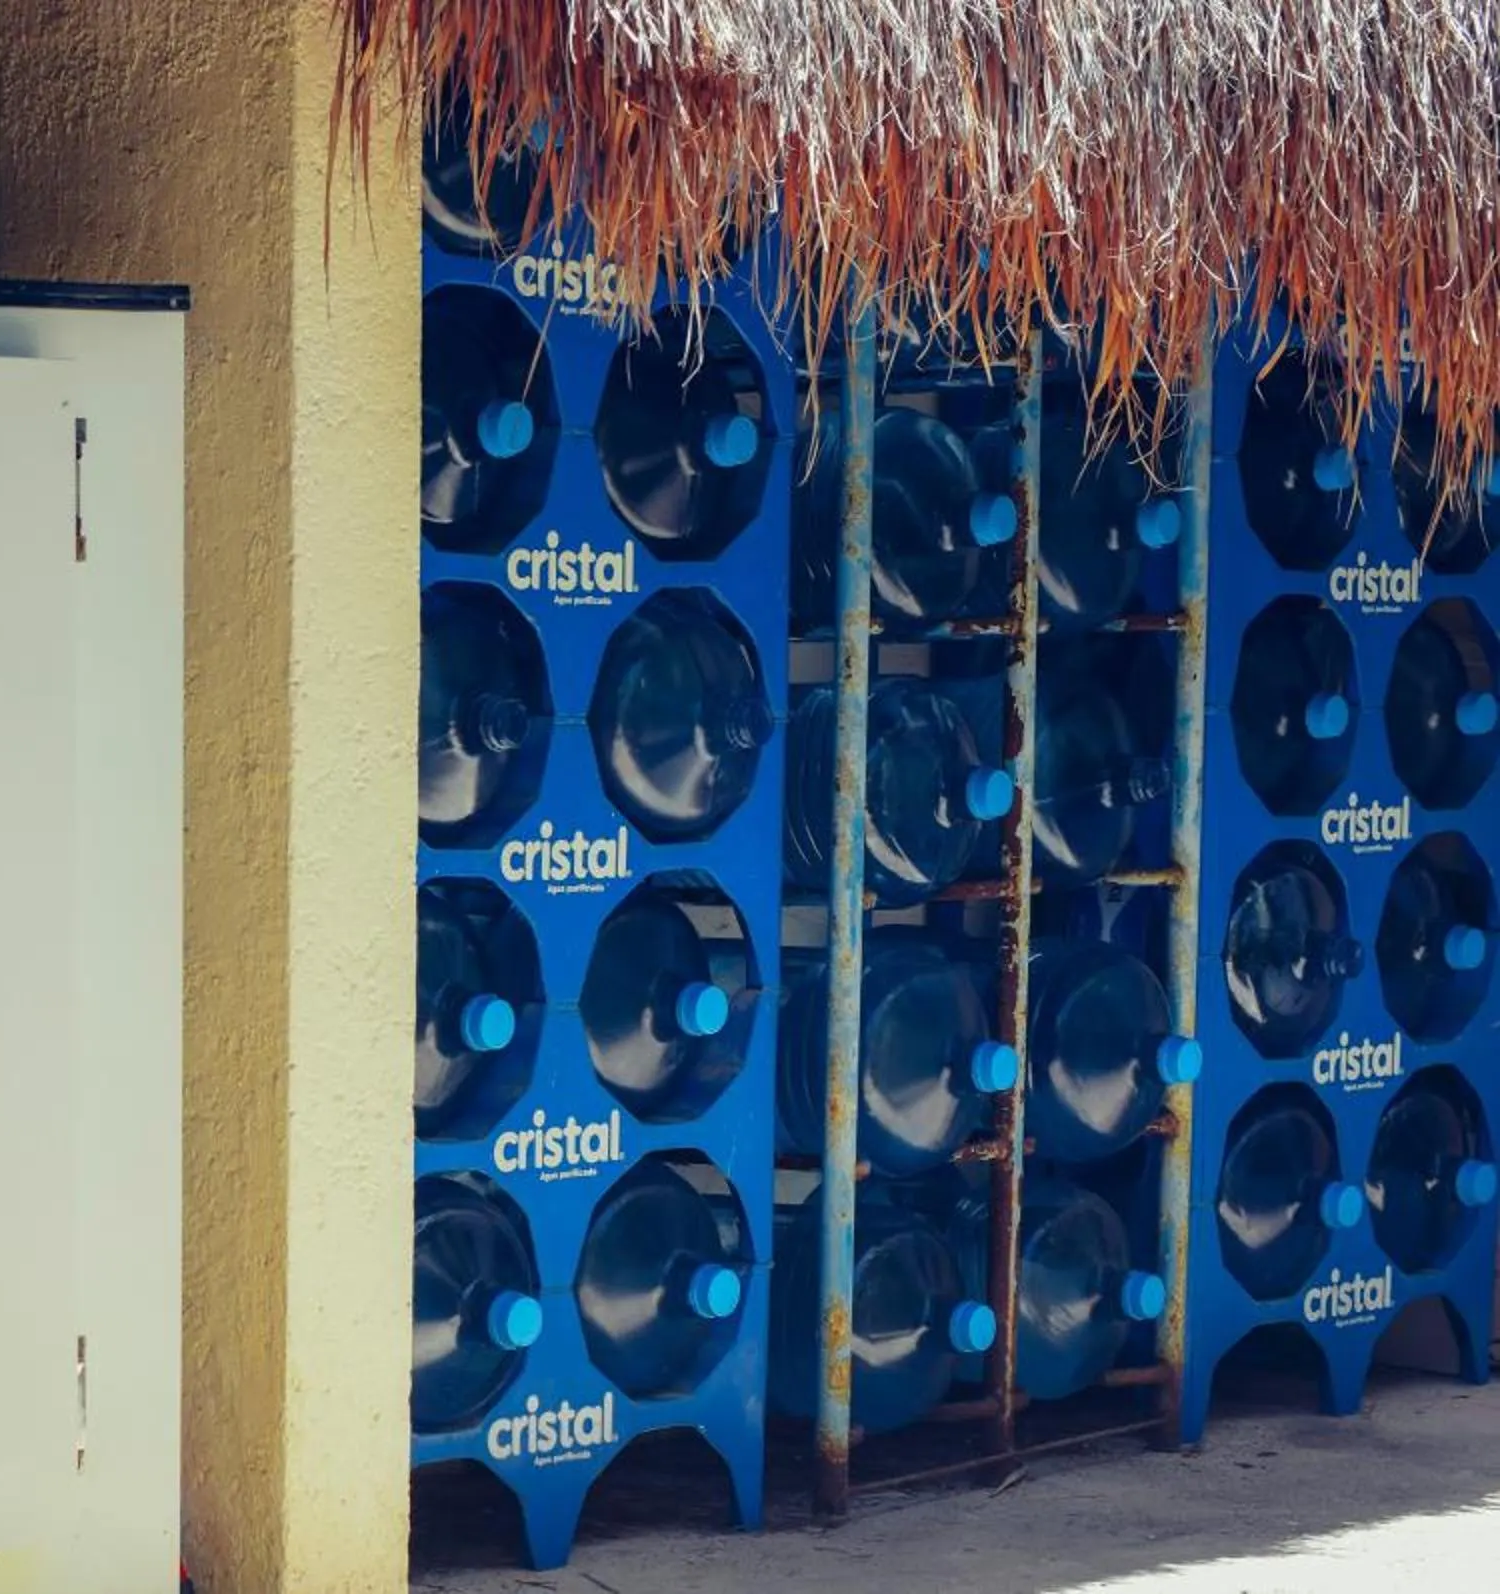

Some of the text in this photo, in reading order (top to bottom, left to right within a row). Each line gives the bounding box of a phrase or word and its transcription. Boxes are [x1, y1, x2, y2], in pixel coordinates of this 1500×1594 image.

[507, 529, 639, 593] cristal
[1329, 551, 1421, 603] cristal
[1321, 791, 1412, 844] cristal
[501, 820, 632, 882] cristal
[1313, 1030, 1404, 1085] cristal
[494, 1108, 625, 1173] cristal
[1303, 1264, 1395, 1322] cristal
[487, 1391, 619, 1460] cristal
